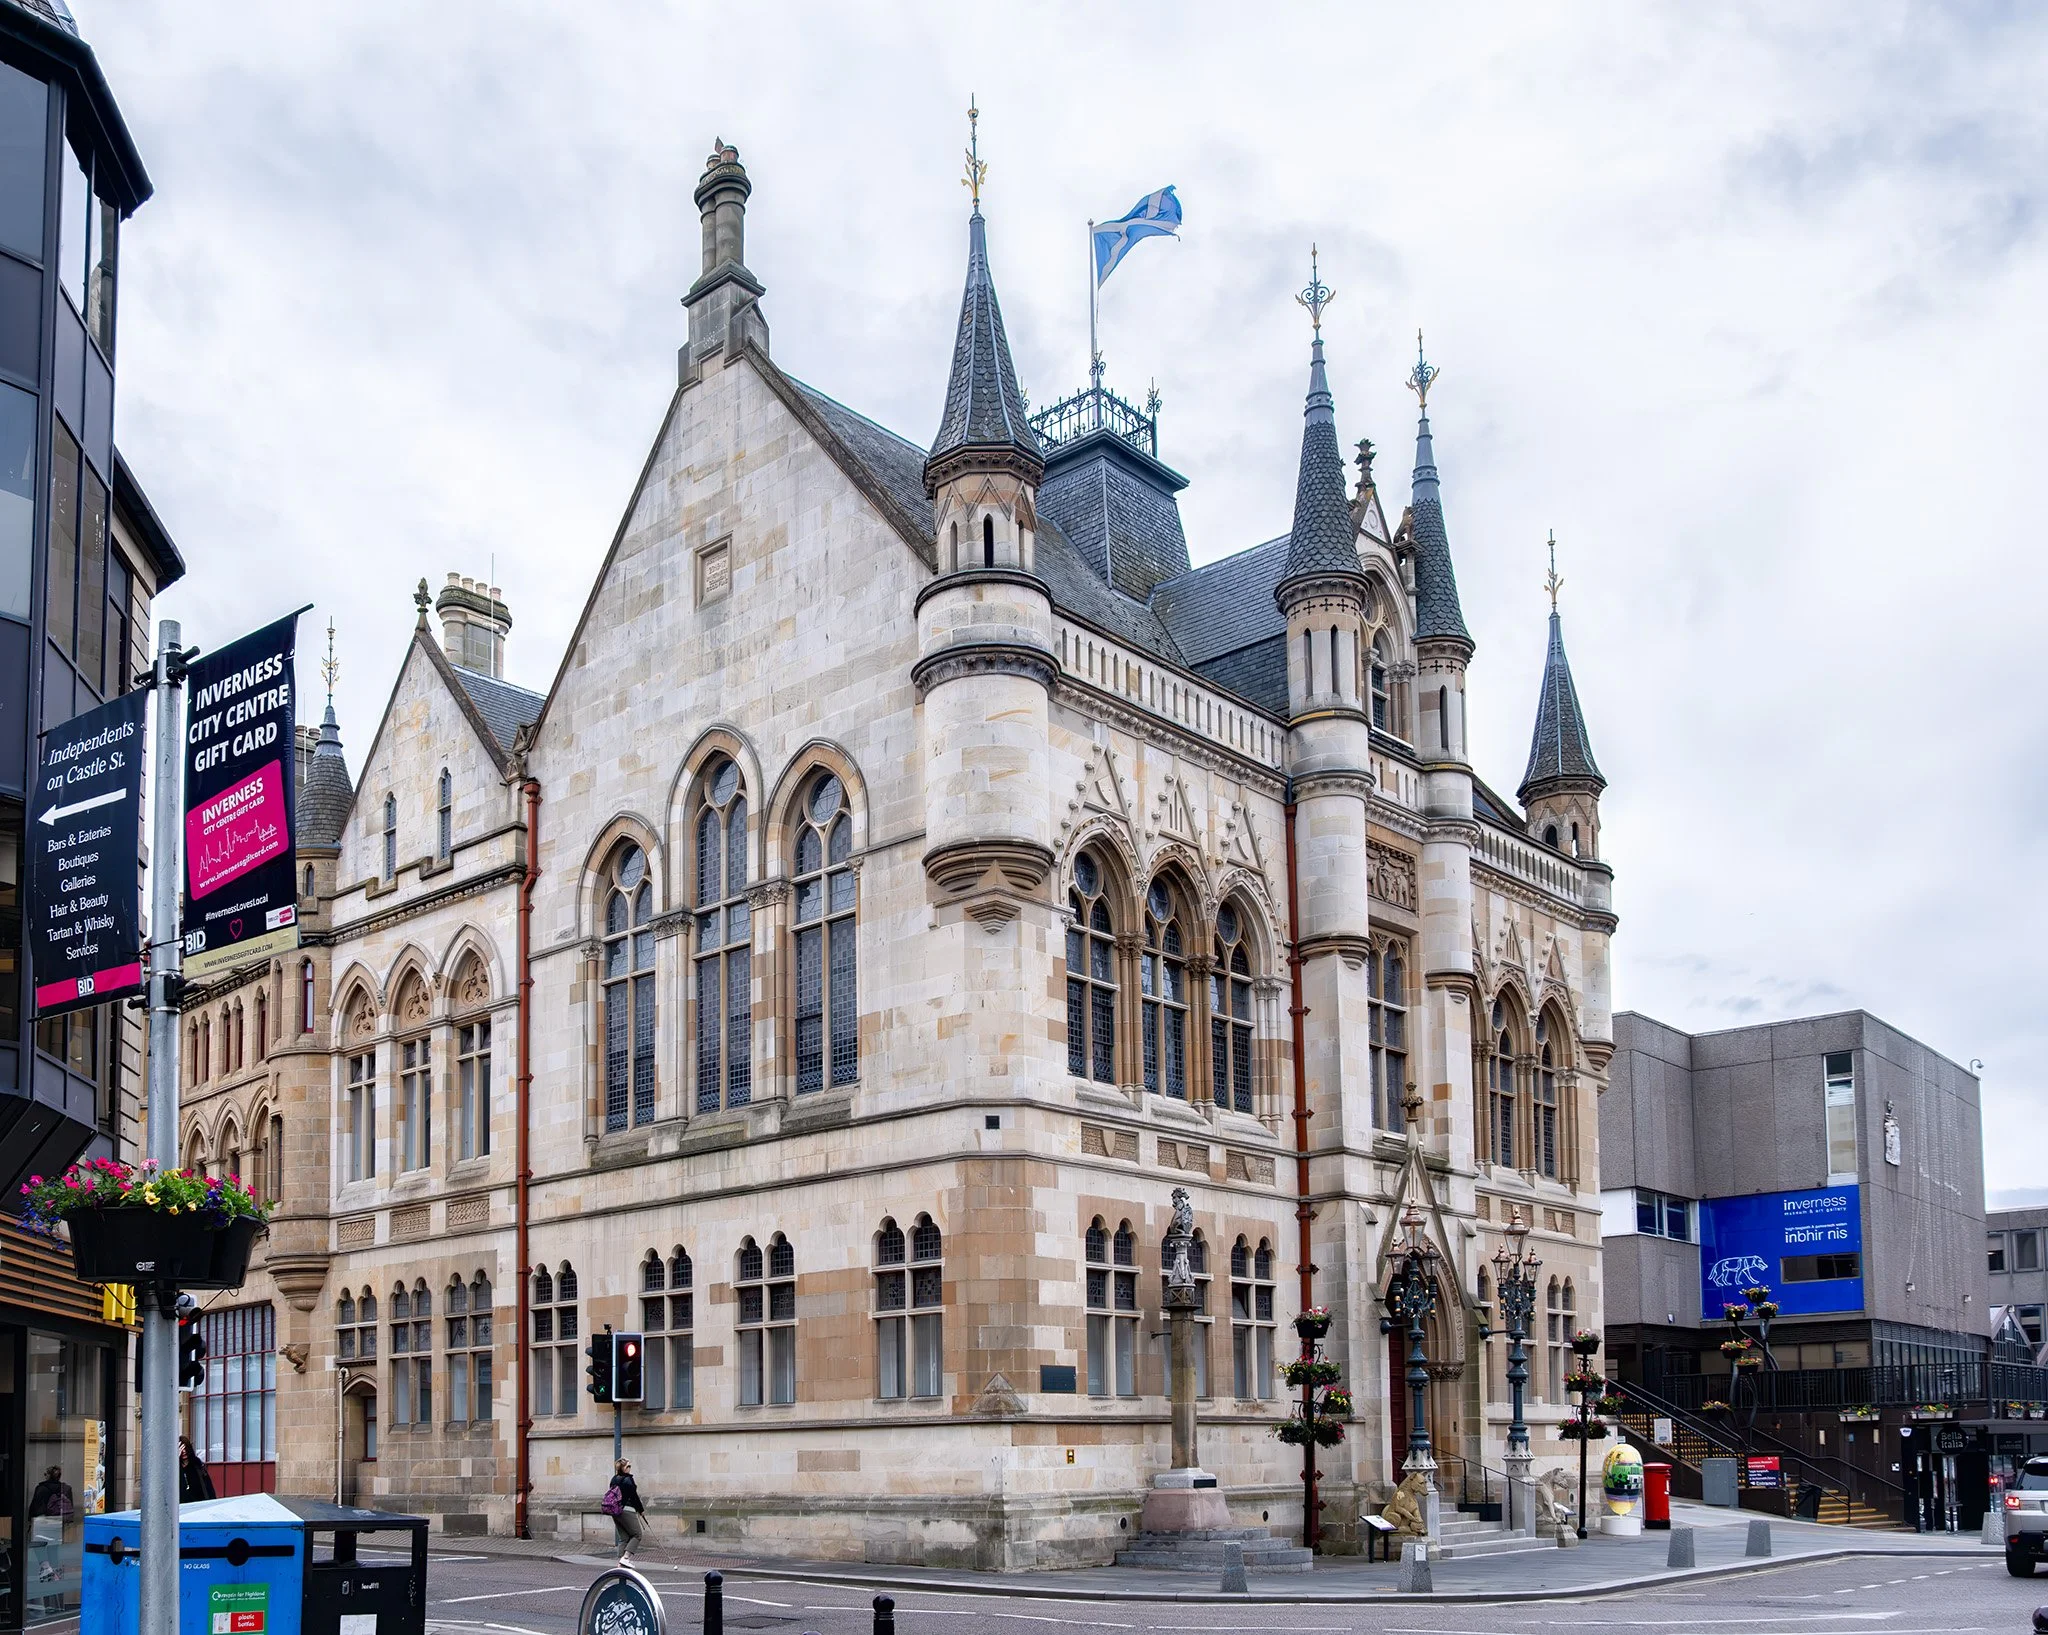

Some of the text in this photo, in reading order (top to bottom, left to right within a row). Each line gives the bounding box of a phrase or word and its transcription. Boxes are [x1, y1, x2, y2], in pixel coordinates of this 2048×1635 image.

[196, 653, 283, 711] INVERNESS
[189, 684, 289, 744] CITY CENTRE
[48, 721, 135, 766] Independents
[195, 722, 277, 772] GIFT CARD
[47, 751, 126, 791] on Castle St.
[202, 777, 264, 824] INVERNESS
[203, 795, 265, 835] CITY CENTRE GIFT CARD
[47, 825, 112, 852] Bars & Eateries
[58, 852, 99, 871] Boutiques
[61, 875, 96, 892] Galleries
[50, 894, 109, 918] Hair & Beauty
[47, 915, 115, 942] Tartan & Whisky
[66, 943, 99, 960] Services
[185, 930, 206, 953] BID
[77, 977, 95, 995] BID
[1783, 1196, 1846, 1210] inverness
[1785, 1227, 1848, 1243] inbhir nis
[1941, 1432, 1962, 1440] Bella
[1941, 1440, 1963, 1448] Italia
